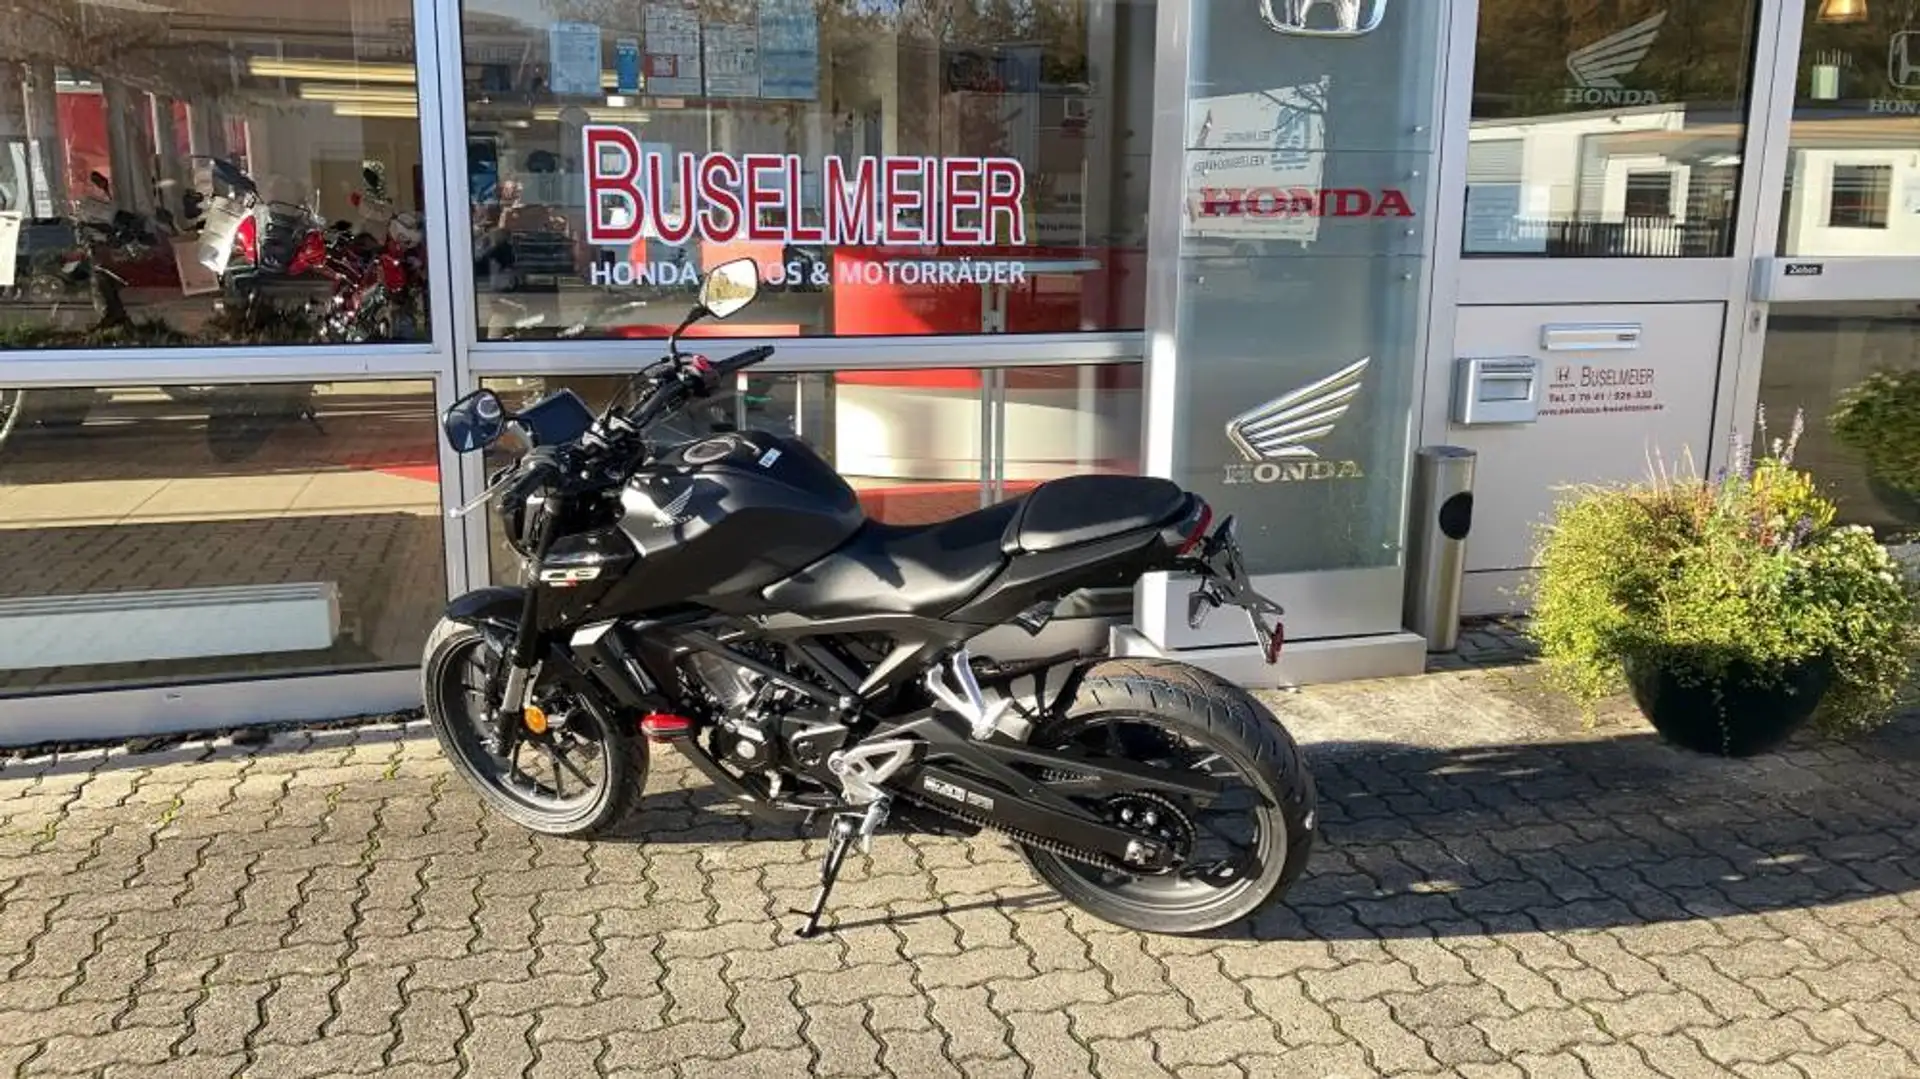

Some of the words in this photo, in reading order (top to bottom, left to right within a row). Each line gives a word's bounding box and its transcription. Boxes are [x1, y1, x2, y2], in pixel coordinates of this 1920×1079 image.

[1564, 88, 1659, 104] HONDA
[1869, 99, 1920, 114] HON
[582, 125, 1026, 246] BUSELMEIER
[1201, 187, 1416, 218] HONDA
[590, 260, 699, 286] HONDA
[809, 261, 831, 286] &
[839, 255, 1025, 286] MOTORRÄDER
[1222, 459, 1365, 485] HONDA
